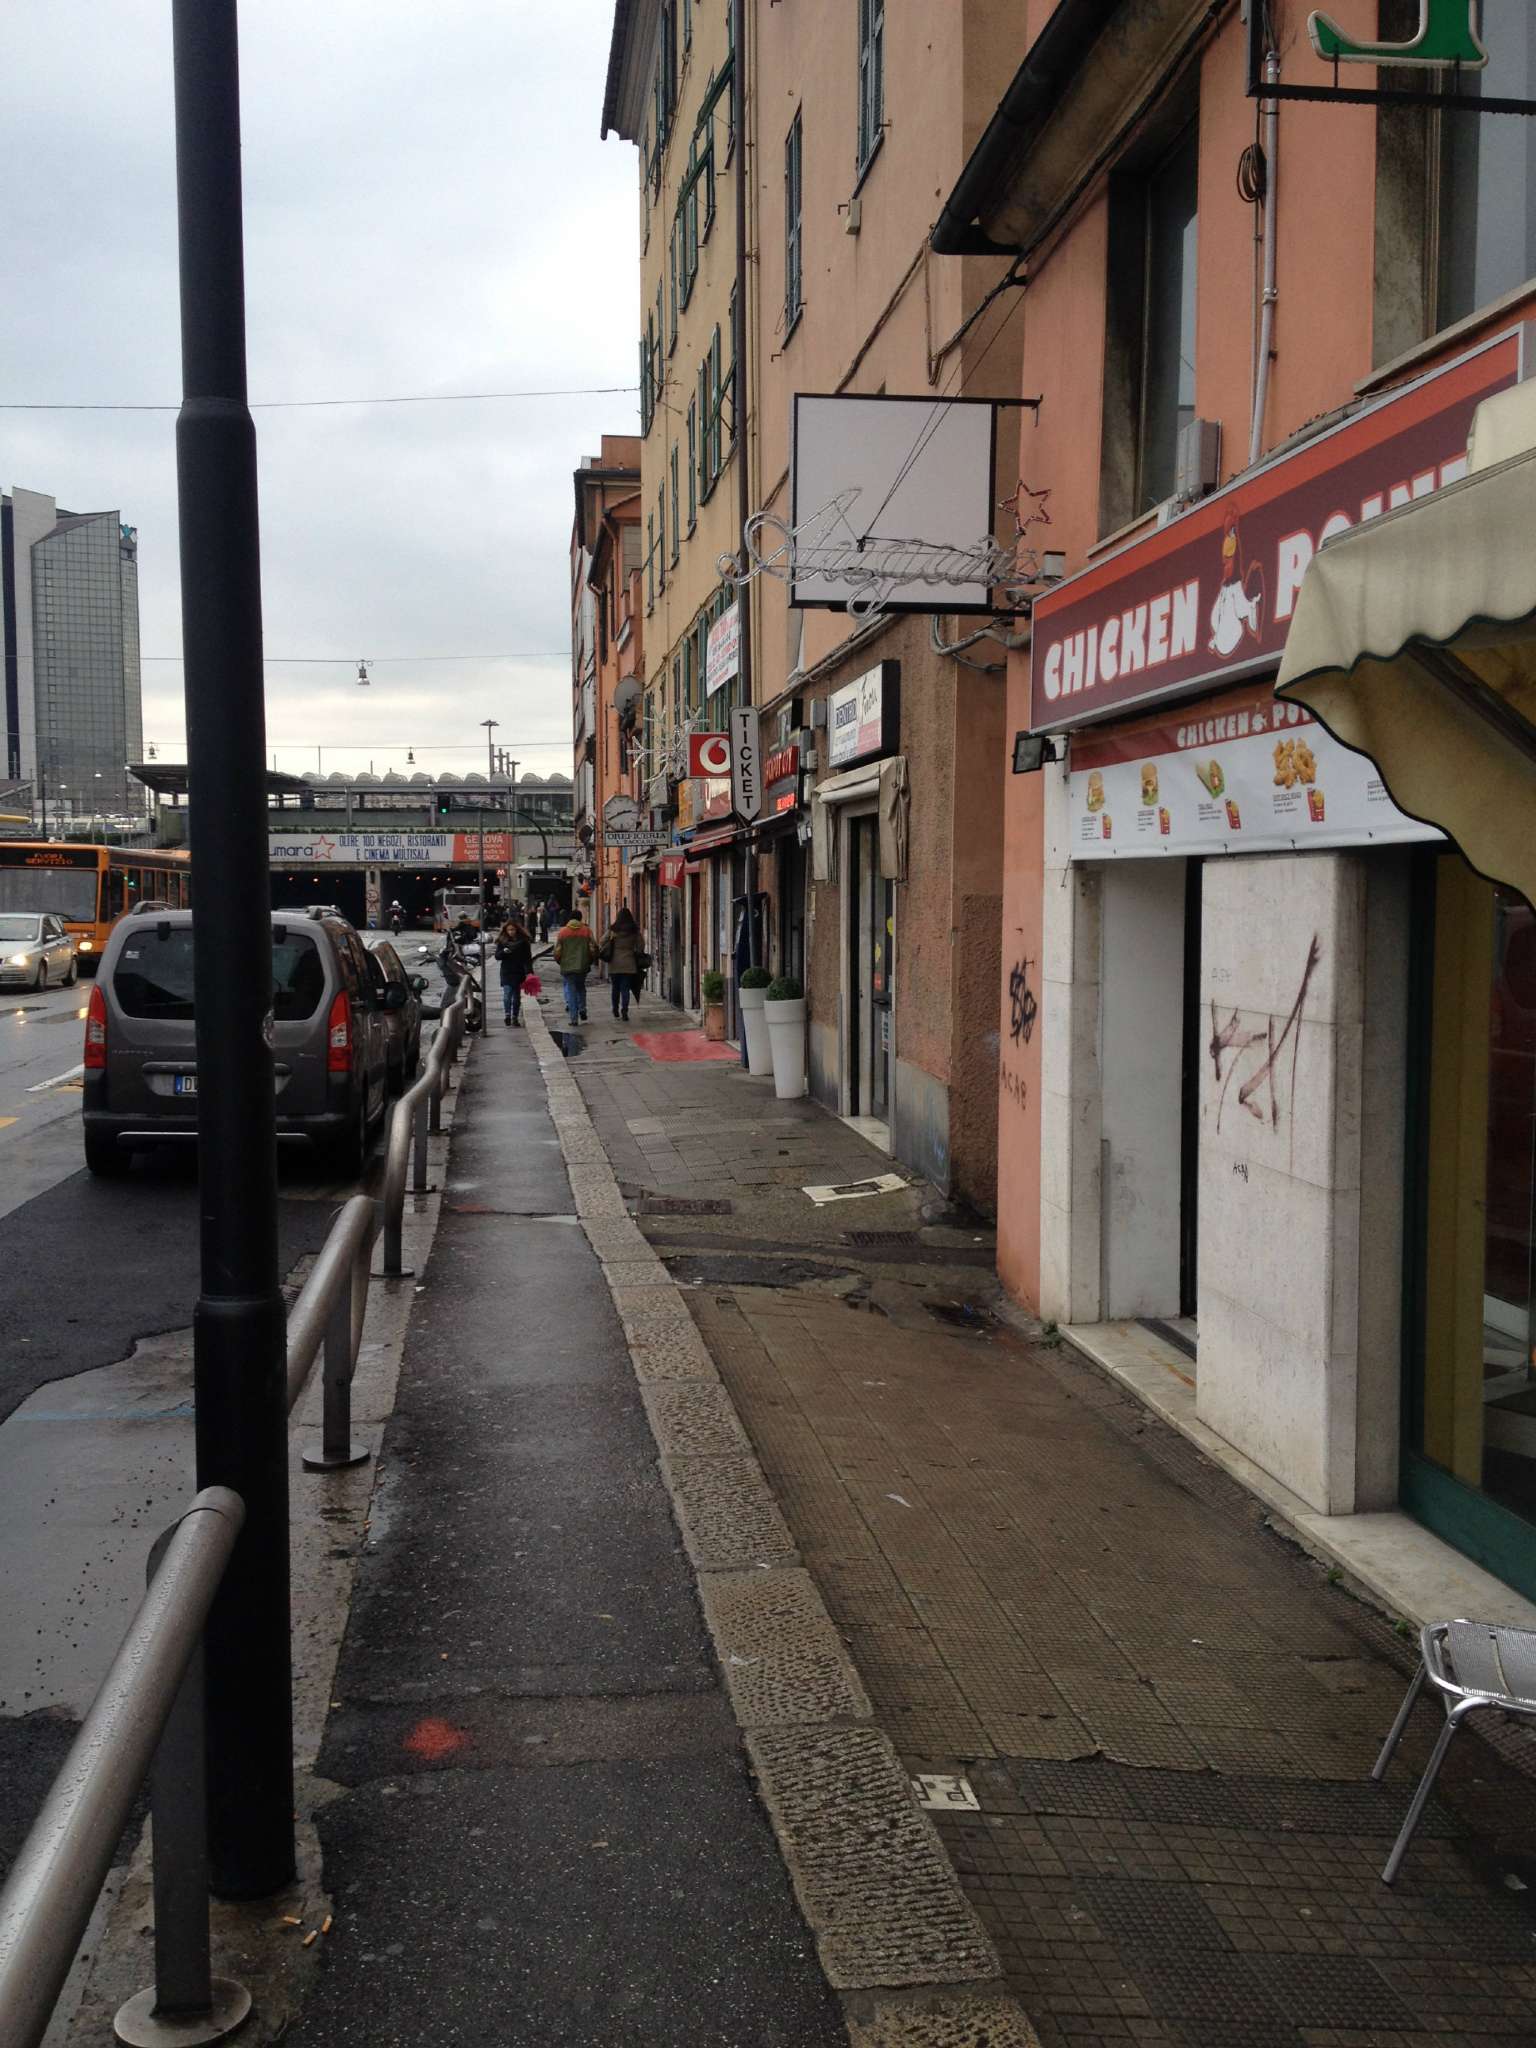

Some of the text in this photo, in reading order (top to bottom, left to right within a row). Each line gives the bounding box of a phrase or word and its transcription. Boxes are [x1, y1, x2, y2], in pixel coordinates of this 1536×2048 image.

[1043, 579, 1200, 701] CHICKEN
[1177, 712, 1249, 748] CHICKEN
[739, 713, 754, 809] TICKET
[339, 835, 359, 847] OLTRE
[363, 835, 375, 847] 100
[407, 835, 447, 847] RISTORANTI
[607, 832, 667, 840] OREFICERIA
[364, 848, 390, 860] CINEMA
[393, 848, 430, 860] MULTISALA
